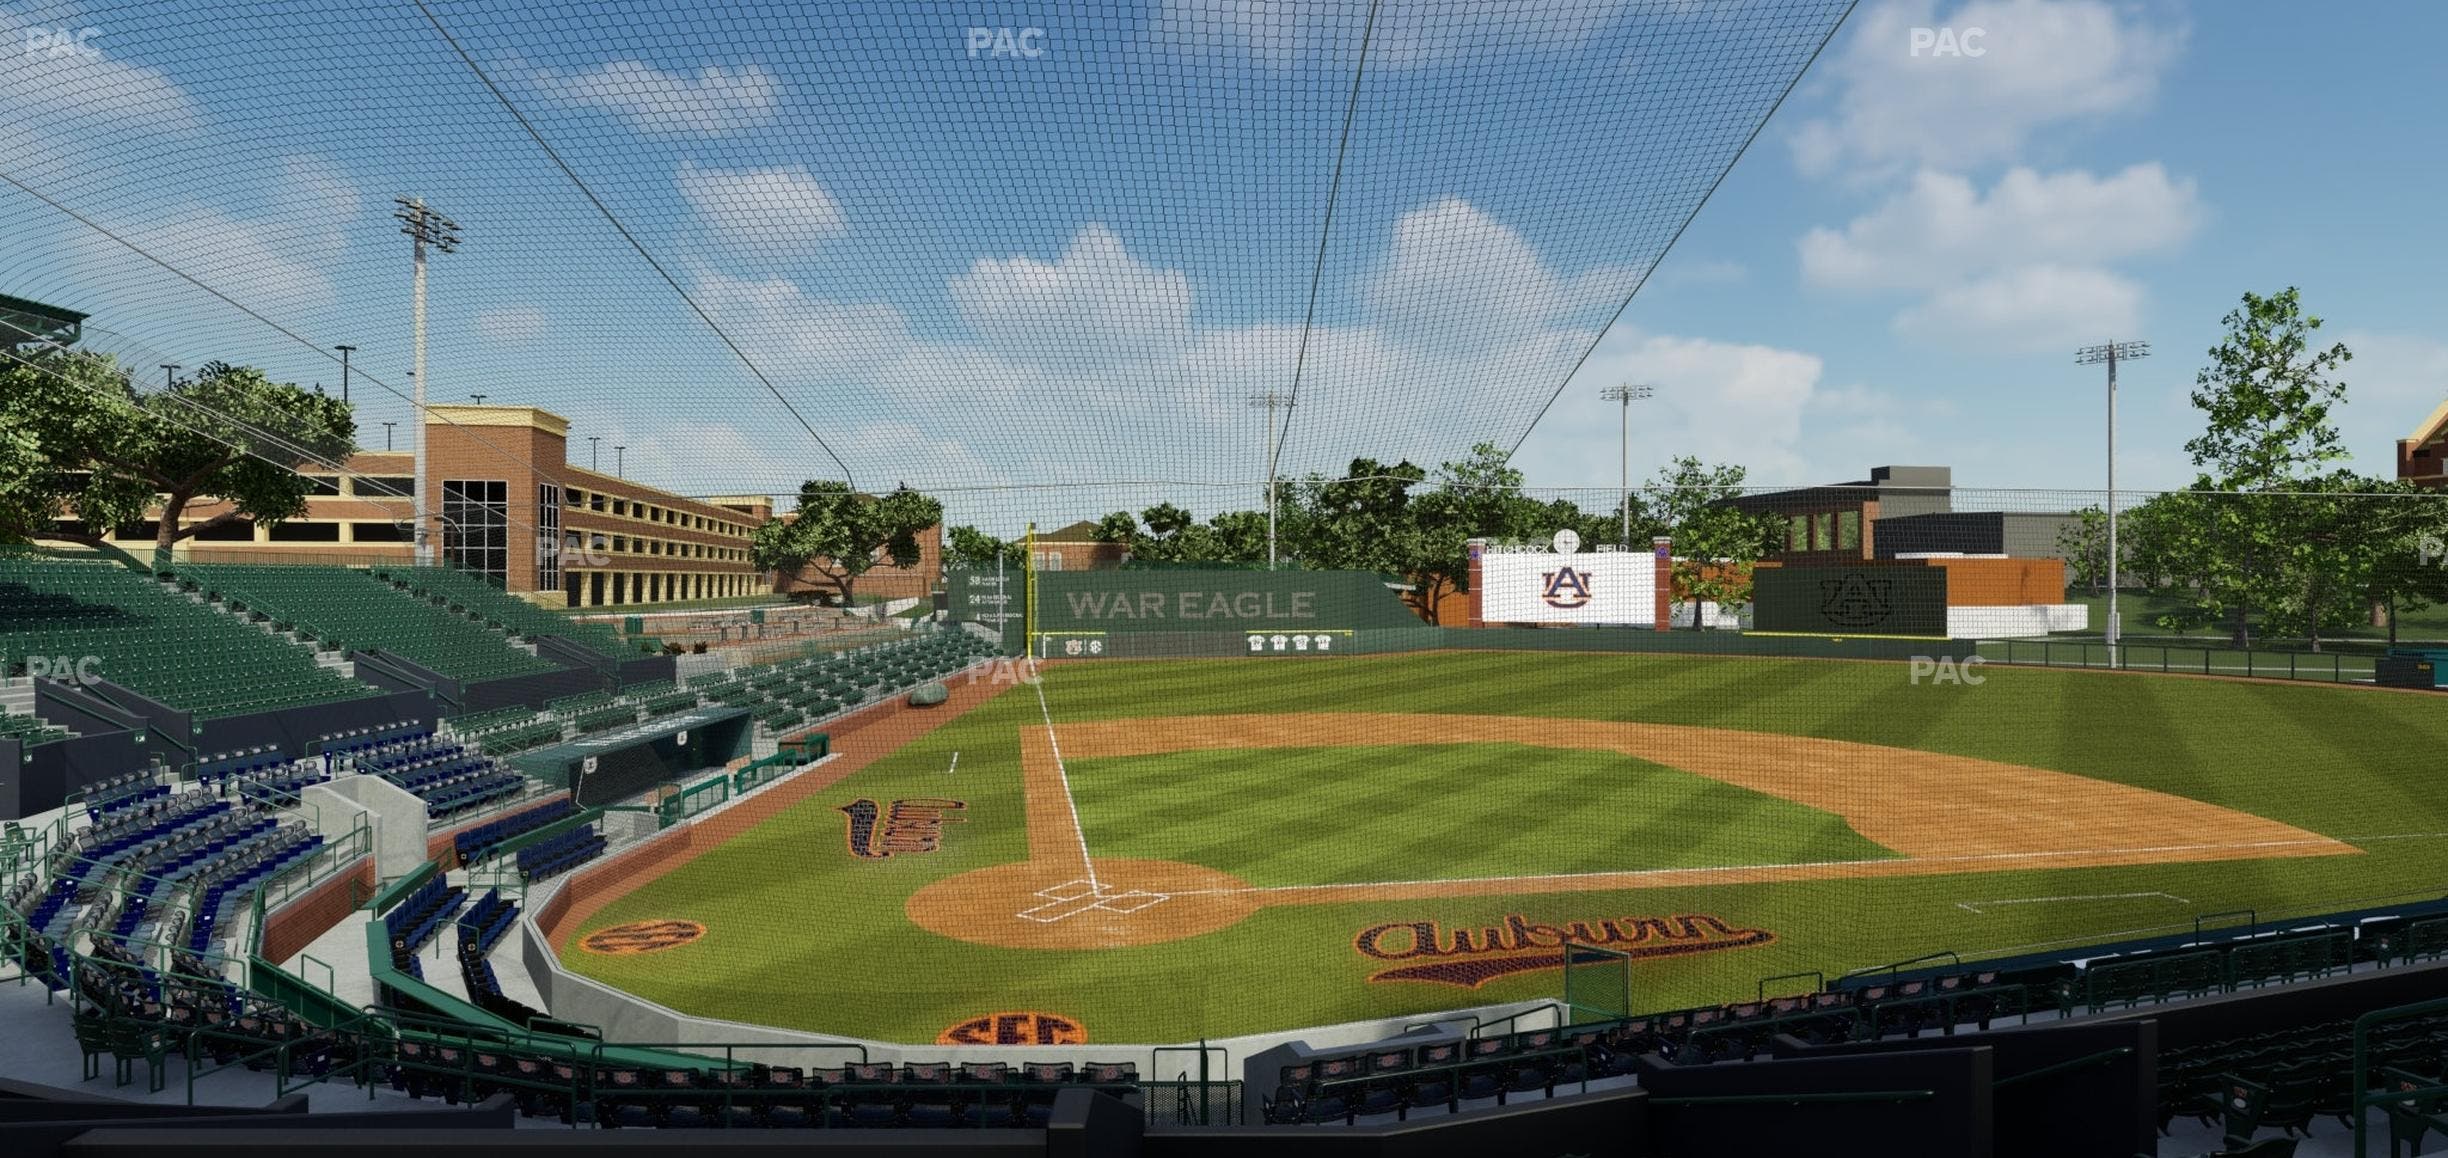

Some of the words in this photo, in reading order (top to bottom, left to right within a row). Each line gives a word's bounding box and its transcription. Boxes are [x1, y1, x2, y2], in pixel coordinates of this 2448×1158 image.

[1486, 544, 1549, 554] HITCHCOCK
[1596, 544, 1629, 553] FIELD
[1066, 591, 1166, 620] WAR
[1178, 591, 1316, 620] EAGLE
[1354, 912, 1774, 964] Auburn
